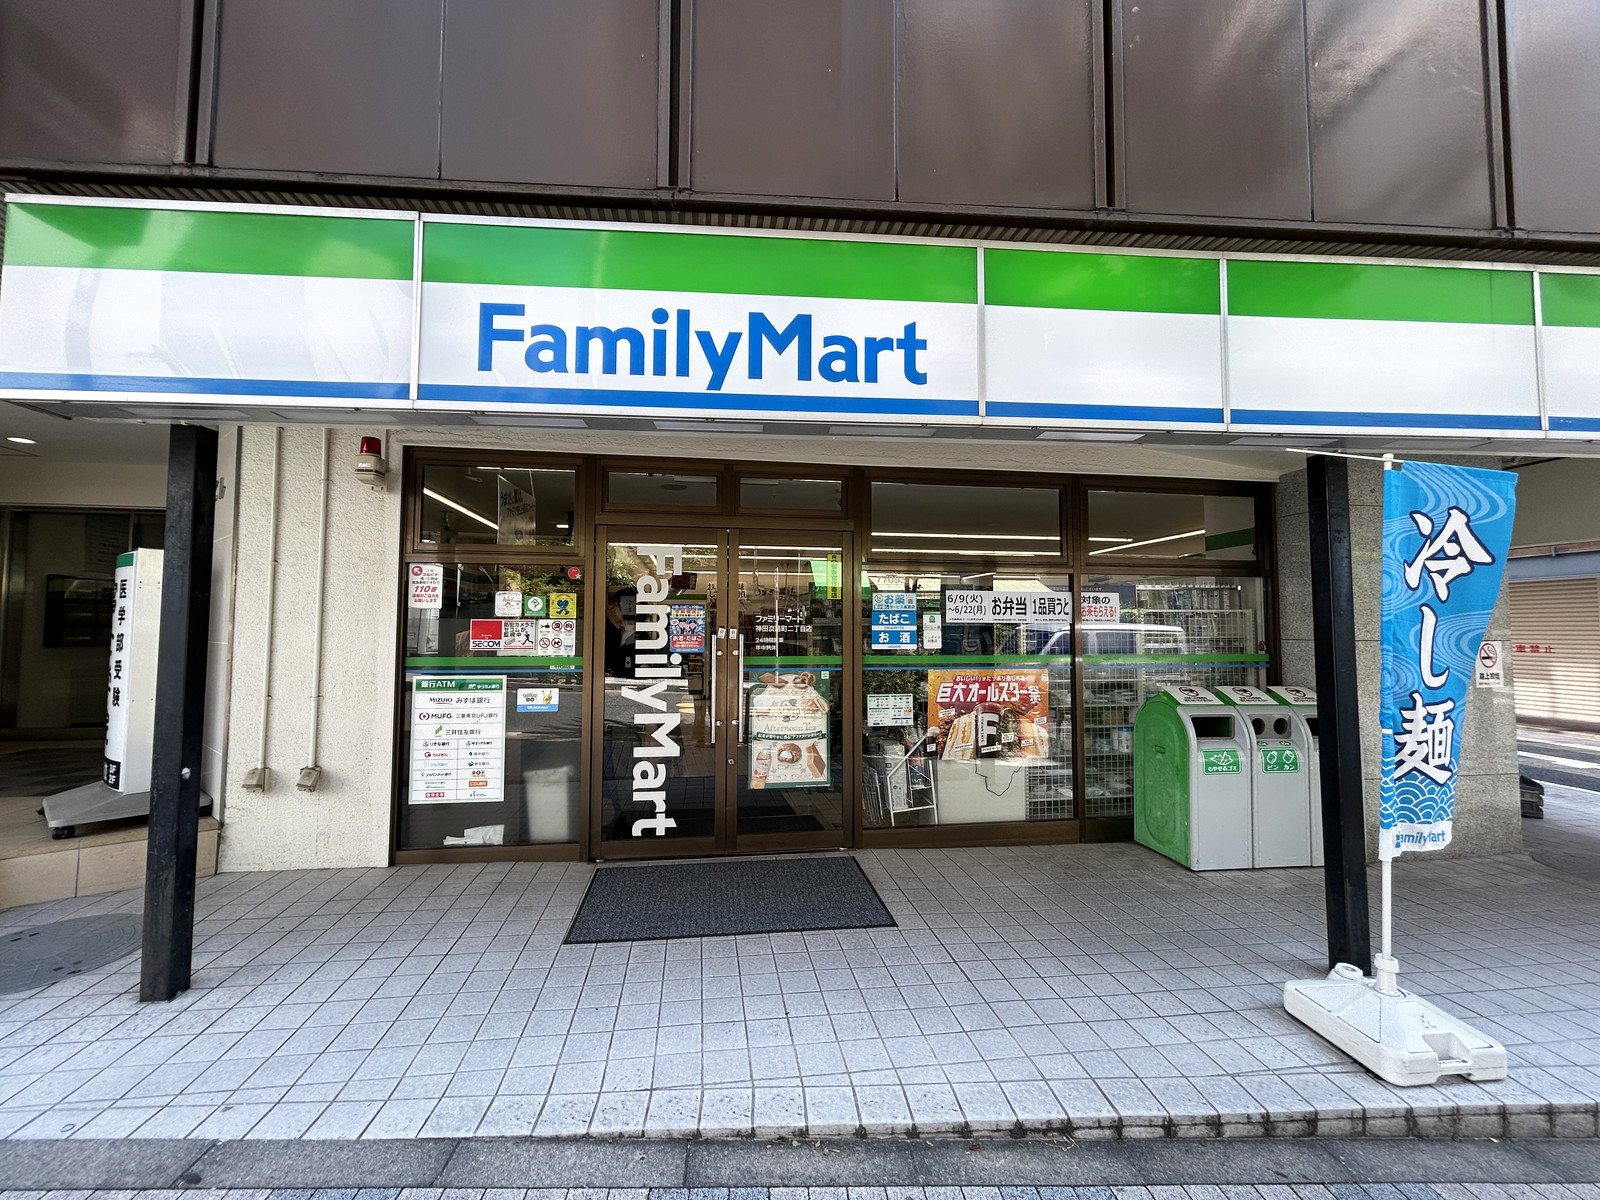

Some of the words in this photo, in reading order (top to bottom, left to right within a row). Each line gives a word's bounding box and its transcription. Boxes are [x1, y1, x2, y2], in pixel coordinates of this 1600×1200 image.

[477, 302, 928, 391] FamilyMart
[884, 594, 905, 604] お薬
[947, 594, 984, 604] 6/9(火)
[1081, 595, 1110, 604] 対象の
[992, 596, 1027, 616] お弁当
[1032, 597, 1070, 616] 1品買うと
[1081, 606, 1117, 618] お茶もらえる!
[755, 615, 804, 623] ファミリーマート
[878, 613, 910, 624] たばこ
[755, 624, 812, 632] 神田淡路町二丁目店
[1394, 505, 1496, 785] 冷し麺
[621, 546, 683, 837] FamilyMart
[936, 682, 1042, 704] 巨大オールスター祭
[763, 723, 803, 732] Afternoon
[804, 722, 817, 730] Tea
